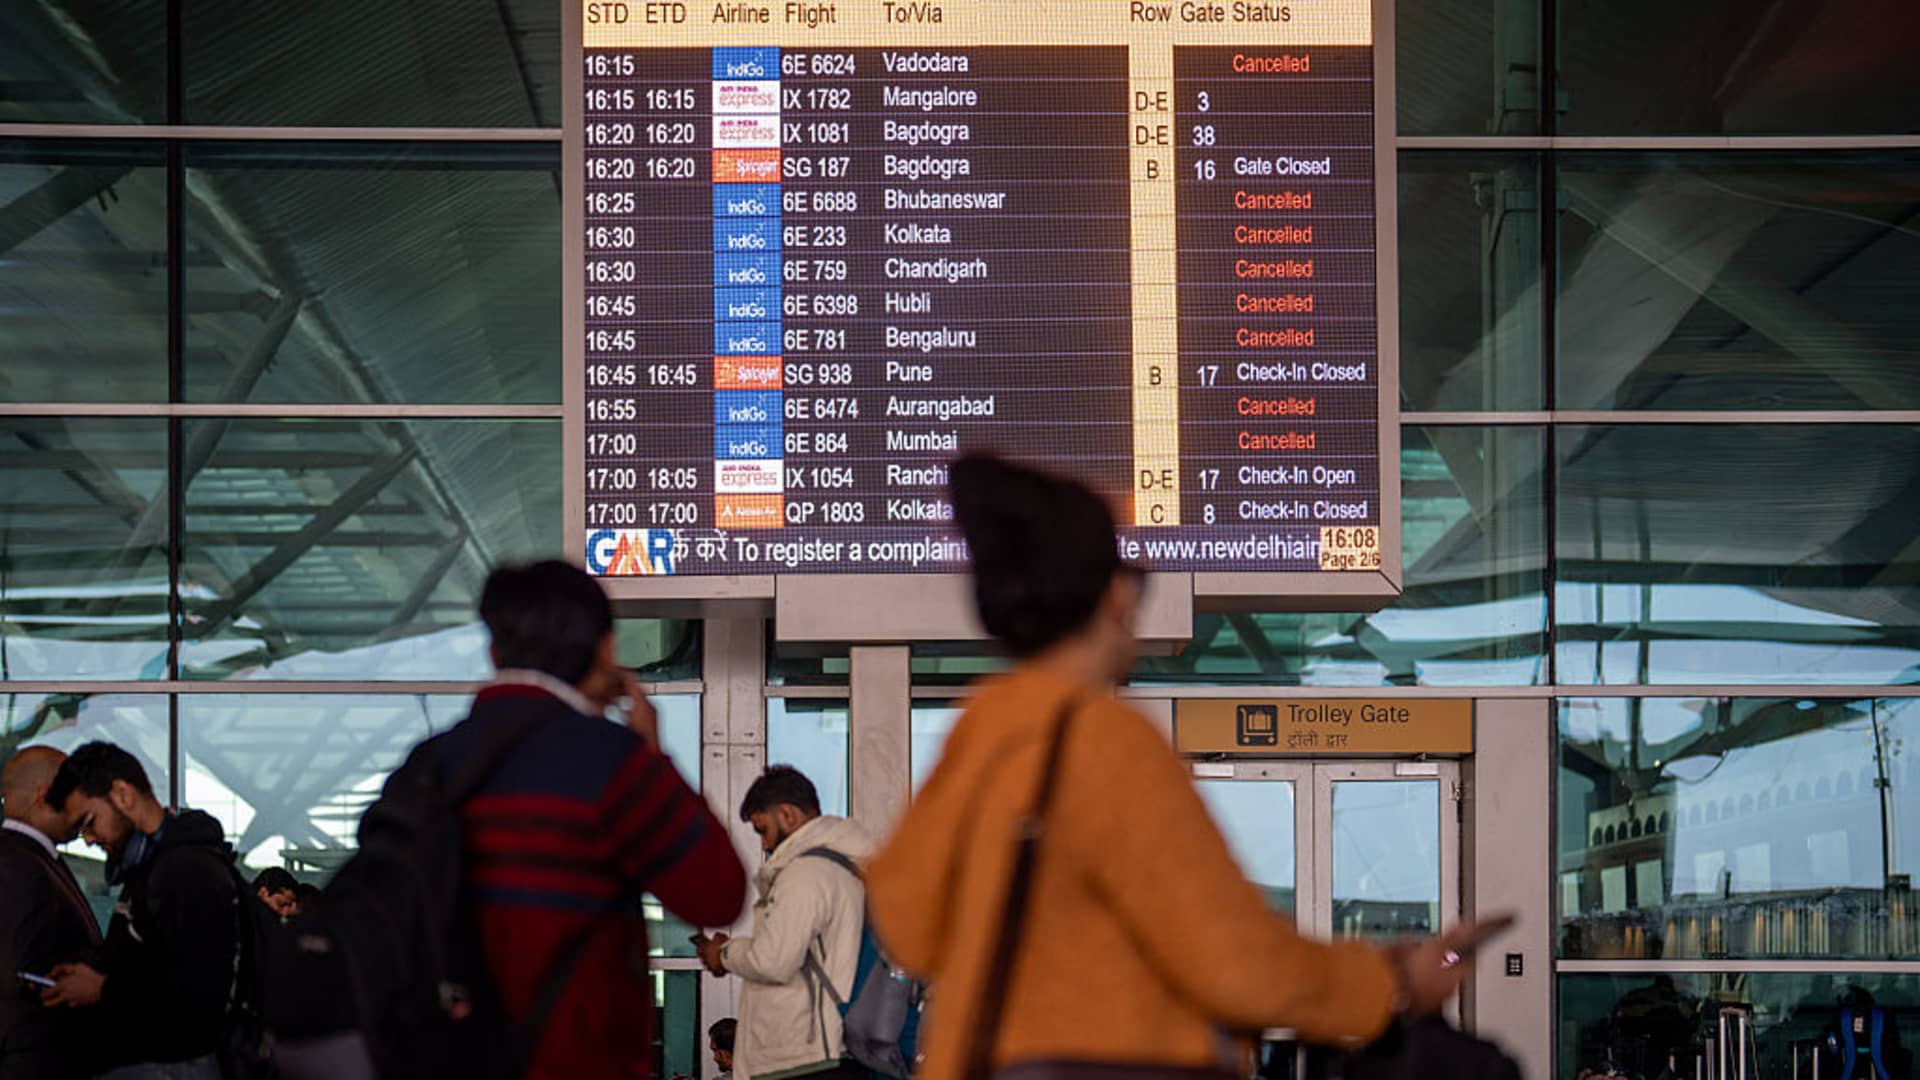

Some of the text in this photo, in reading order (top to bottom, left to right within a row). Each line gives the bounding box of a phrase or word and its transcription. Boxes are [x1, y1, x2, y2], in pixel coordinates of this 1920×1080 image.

[587, 2, 1291, 28] STD ETD Airline Flight To/Via Row Gate Status
[585, 56, 634, 75] 16:15
[782, 55, 806, 75] 6E
[812, 55, 855, 75] 6624
[883, 52, 968, 73] Vadodara
[1233, 54, 1310, 73] Cancelled
[585, 90, 634, 110] 16:15
[646, 90, 695, 109] 16:15
[784, 89, 802, 108] IX
[808, 89, 850, 108] 1782
[883, 87, 977, 111] Mangalore
[1135, 92, 1168, 110] D-E
[1198, 92, 1209, 111] 3
[585, 124, 634, 144] 16:20
[646, 124, 695, 143] 16:20
[784, 123, 802, 143] IX
[808, 123, 849, 143] 1081
[884, 120, 969, 144] Bagdogra
[1135, 126, 1169, 144] D-E
[1193, 126, 1215, 145] 38
[585, 159, 634, 178] 16:20
[646, 158, 695, 178] 16:20
[784, 158, 811, 177] SG
[818, 157, 850, 177] 187
[884, 155, 970, 179] Bagdogra
[1147, 160, 1159, 178] B
[1194, 160, 1216, 179] 16
[1234, 157, 1272, 175] Gate
[1276, 157, 1330, 175] Closed
[585, 193, 634, 213] 16:25
[784, 192, 807, 212] 6E
[813, 192, 857, 212] 6688
[884, 189, 1005, 209] Bhubaneswar
[1235, 191, 1312, 209] Cancelled
[586, 228, 635, 248] 16:30
[784, 227, 807, 246] 6E
[813, 227, 846, 246] 233
[885, 224, 951, 243] Kolkata
[1235, 225, 1312, 243] Cancelled
[586, 262, 635, 282] 16:30
[784, 261, 807, 280] 6E
[814, 261, 846, 280] 759
[885, 259, 987, 283] Chandigarh
[1236, 260, 1313, 277] Cancelled
[586, 296, 635, 316] 16:45
[784, 296, 808, 315] 6E
[814, 296, 858, 315] 6398
[885, 293, 931, 312] Hubli
[1237, 294, 1313, 312] Cancelled
[586, 330, 635, 350] 16:45
[784, 330, 808, 349] 6E
[815, 330, 845, 349] 781
[886, 327, 976, 352] Bengaluru
[1237, 328, 1314, 346] Cancelled
[586, 365, 636, 385] 16:45
[648, 365, 696, 384] 16:45
[785, 364, 812, 384] SG
[819, 364, 851, 384] 938
[886, 362, 932, 381] Pune
[1150, 367, 1161, 385] B
[1198, 366, 1219, 385] 17
[1237, 363, 1307, 382] Check-In
[1312, 363, 1365, 381] Closed
[586, 400, 636, 420] 16:55
[785, 399, 808, 419] 6E
[815, 399, 859, 419] 6474
[886, 396, 994, 420] Aurangabad
[1238, 397, 1315, 415] Cancelled
[587, 434, 636, 454] 17:00
[785, 433, 809, 453] 6E
[815, 433, 848, 453] 864
[887, 430, 957, 451] Mumbai
[1239, 432, 1315, 449] Cancelled
[587, 469, 636, 489] 17:00
[648, 468, 697, 488] 18:05
[785, 468, 804, 487] IX
[811, 468, 854, 487] 1054
[887, 465, 949, 485] Ranchi
[1140, 470, 1173, 489] D-E
[1199, 469, 1219, 489] 17
[1239, 467, 1307, 485] Check-In
[1314, 467, 1355, 486] Open
[587, 504, 636, 524] 17:00
[648, 503, 697, 522] 17:00
[786, 502, 813, 523] QP
[821, 502, 864, 522] 1803
[887, 499, 954, 520] Kolkata
[1150, 504, 1164, 524] C
[1203, 504, 1215, 524] 8
[1239, 501, 1309, 519] Check-In
[1313, 501, 1367, 518] Closed
[1324, 529, 1375, 548] 16:08
[735, 540, 968, 567] To register a complaint
[1321, 553, 1355, 567] Page
[1288, 704, 1409, 726] Trolley Gate
